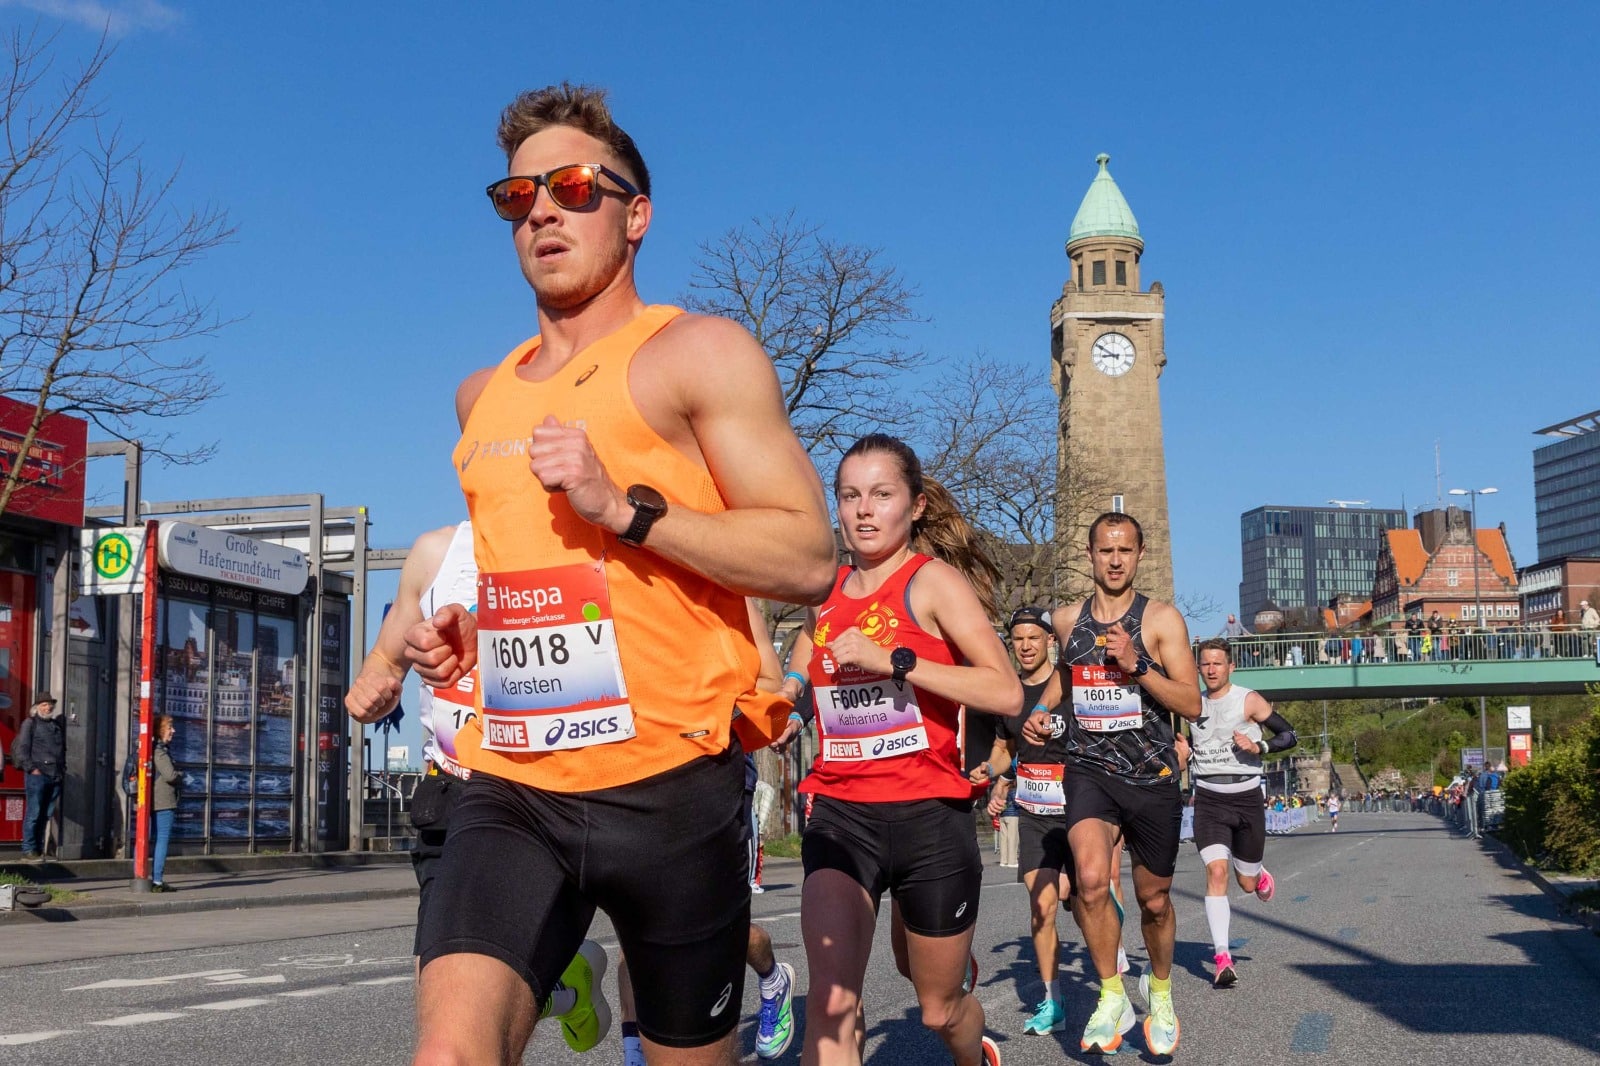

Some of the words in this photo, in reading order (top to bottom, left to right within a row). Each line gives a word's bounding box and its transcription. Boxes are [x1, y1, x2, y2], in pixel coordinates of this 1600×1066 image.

[103, 544, 121, 568] H
[226, 535, 258, 556] Große
[199, 549, 281, 580] Hafenrundfahrt
[499, 586, 563, 612] Haspa
[503, 616, 531, 625] Hamburger
[531, 613, 566, 624] Sparkasse
[492, 633, 570, 669] 16018
[585, 624, 603, 645] V
[1093, 670, 1122, 680] Haspa
[500, 676, 562, 696] Karsten
[1083, 688, 1122, 701] 16015
[1128, 686, 1136, 694] V
[830, 686, 886, 710] F6002
[1088, 703, 1120, 711] Andreas
[839, 712, 888, 726] Katharina
[489, 722, 527, 746] REWE
[567, 716, 619, 740] asics
[830, 742, 861, 758] REWE
[886, 734, 918, 751] asics
[1024, 780, 1050, 792] 16007
